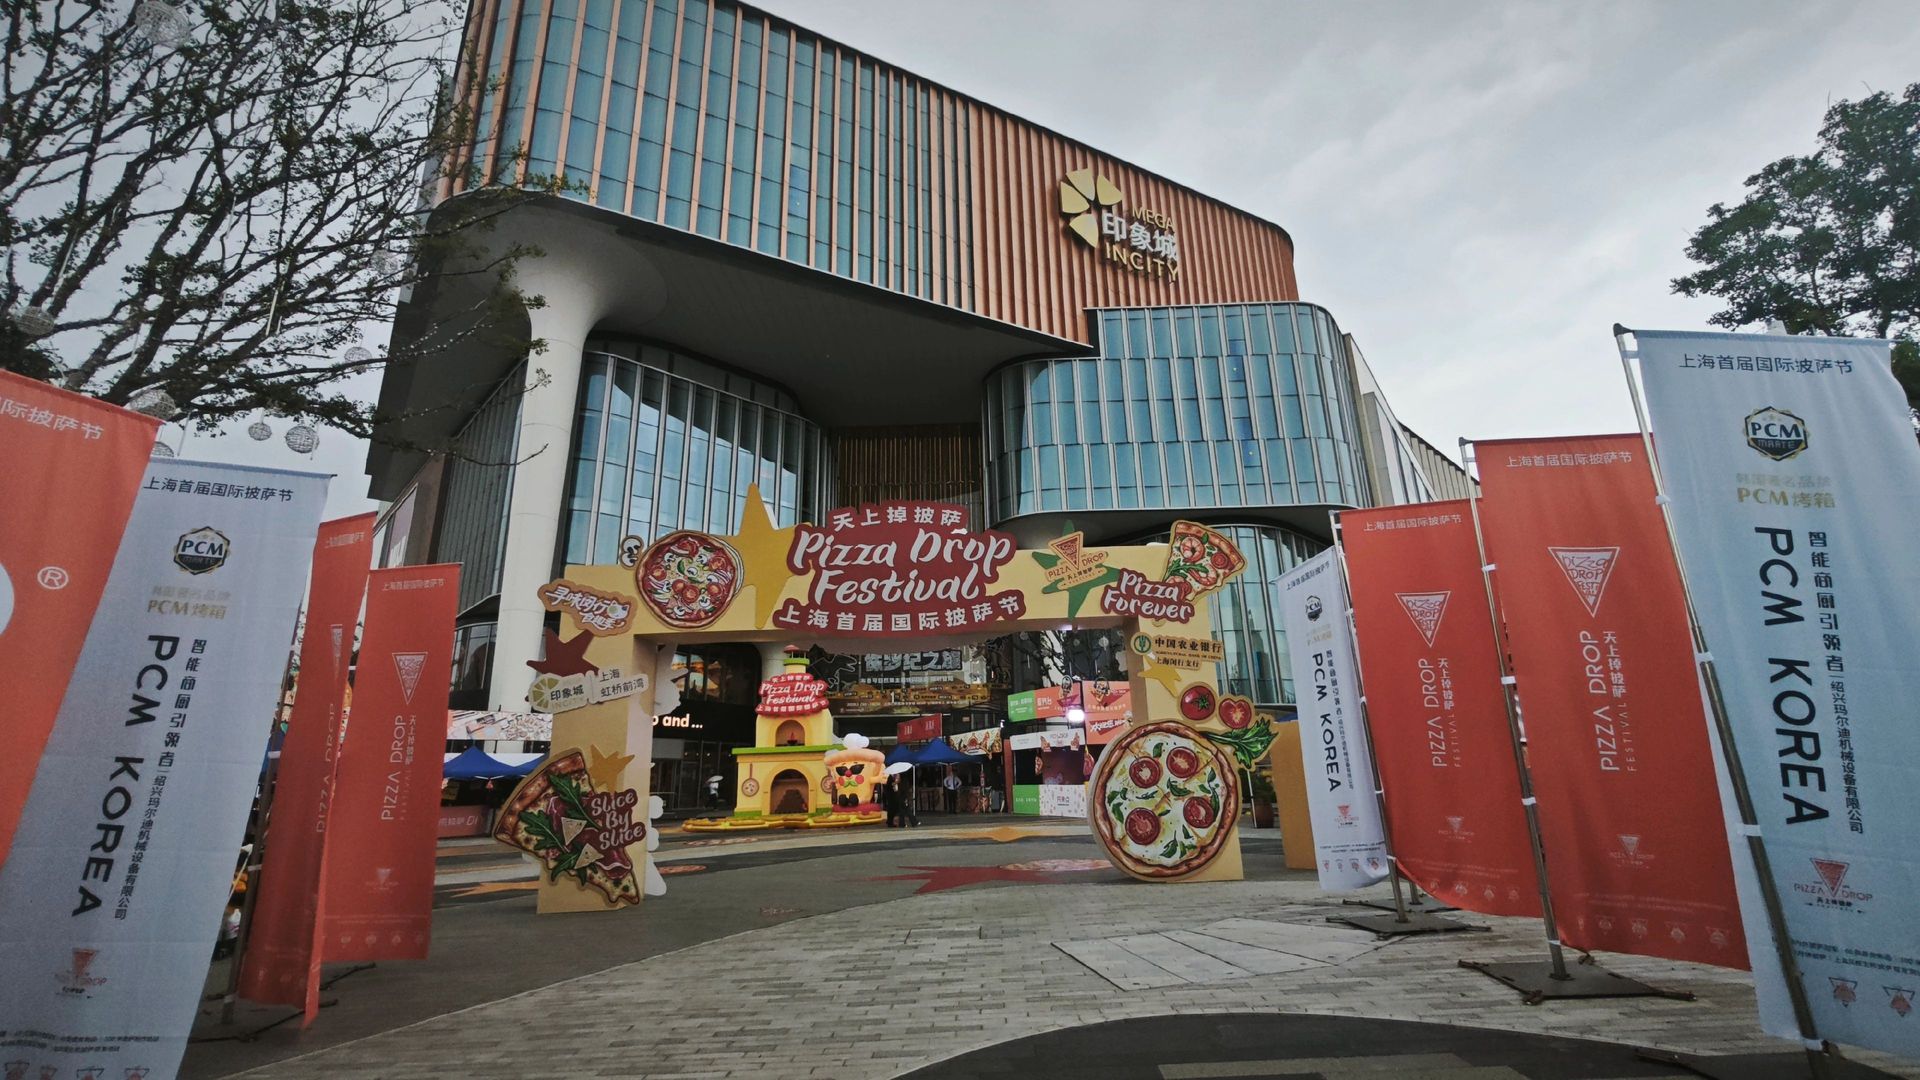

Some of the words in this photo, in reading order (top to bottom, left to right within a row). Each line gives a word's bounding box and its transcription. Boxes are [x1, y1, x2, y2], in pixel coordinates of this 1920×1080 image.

[1102, 212, 1179, 260] 印象城
[1132, 206, 1175, 233] MEGA
[1105, 242, 1179, 283] INCITY
[1679, 353, 1854, 374] 上海首届国际披萨节
[1751, 422, 1802, 438] PCM
[1506, 451, 1632, 468] 上海首届国际披萨节
[143, 476, 294, 502] 上海首届国际披萨节
[833, 505, 963, 532] 天上掉披萨
[181, 540, 223, 556] PCM
[793, 530, 899, 569] Pizza
[909, 528, 1011, 578] Drop
[1081, 552, 1104, 567] DROP
[814, 563, 980, 605] Festival
[1120, 572, 1179, 602] Pizza
[1754, 526, 1805, 627] PCM
[779, 595, 1020, 632] 上海首届国际披萨节
[1104, 588, 1192, 619] Forever
[1808, 531, 1844, 673] 智能商厨引领者
[1154, 638, 1222, 653] 中国农业银行
[1579, 630, 1607, 695] DROP
[125, 634, 180, 727] PCM
[550, 684, 584, 700] 印象城
[600, 669, 620, 682] 上海
[761, 682, 791, 695] Pizza
[794, 682, 825, 696] Drop
[1312, 653, 1328, 702] PCM
[1418, 658, 1440, 709] DROP
[766, 690, 816, 705] Festival
[389, 715, 407, 764] DROP
[1319, 713, 1341, 792] KOREA
[1427, 716, 1448, 768] PIZZA
[1593, 705, 1620, 771] PIZZA
[1617, 702, 1637, 772] FESTIVAL
[1768, 657, 1830, 825] KOREA
[381, 770, 401, 821] PIZZA
[591, 791, 635, 816] Slice
[71, 756, 144, 917] KOREA
[599, 825, 643, 850] Slice
[605, 810, 630, 834] By
